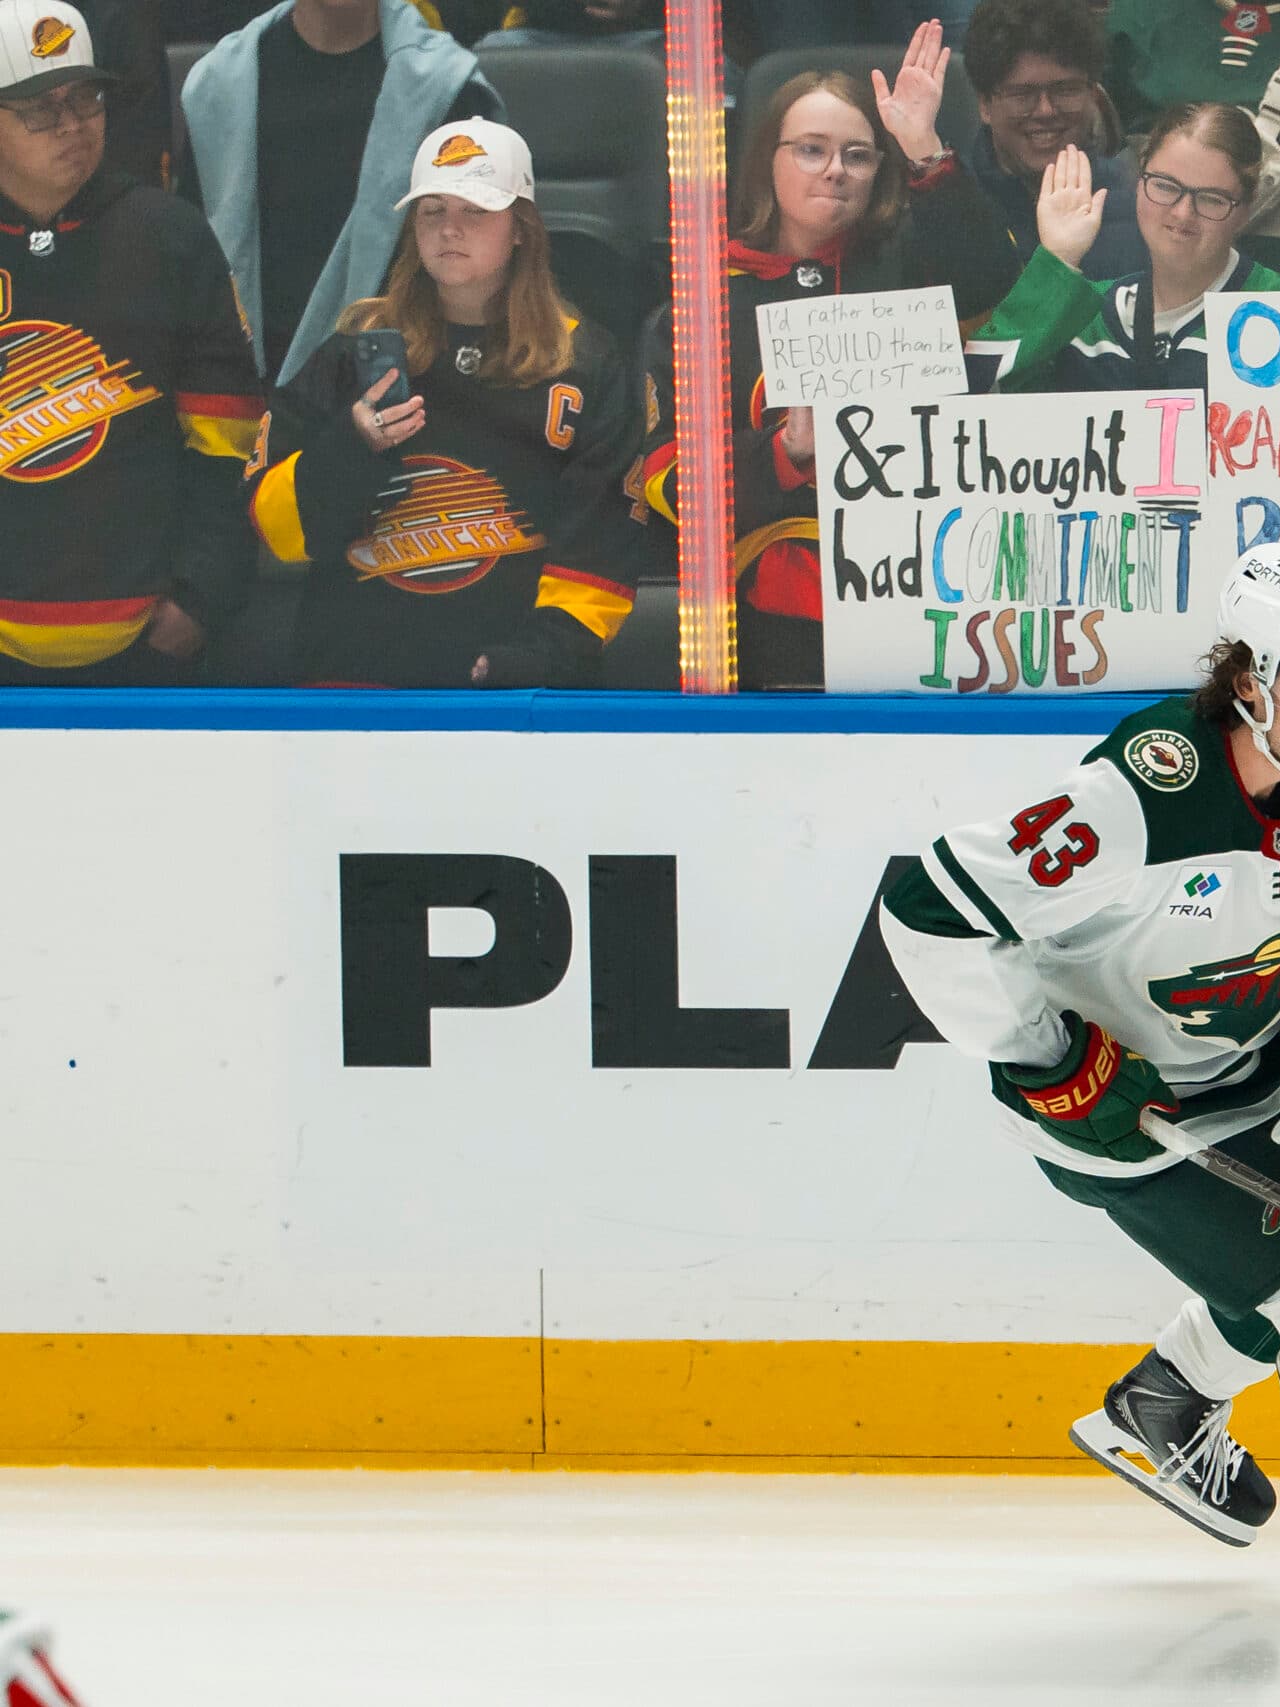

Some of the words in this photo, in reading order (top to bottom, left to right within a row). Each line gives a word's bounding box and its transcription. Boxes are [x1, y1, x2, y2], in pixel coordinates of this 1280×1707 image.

[766, 308, 791, 334] I'd
[808, 302, 863, 326] rather
[872, 298, 895, 317] be
[908, 302, 927, 312] in
[935, 298, 948, 311] a
[772, 331, 881, 369] REBUILD
[890, 327, 932, 358] than
[776, 378, 786, 392] a
[800, 362, 914, 399] FASCIST
[0, 376, 122, 458] NUCKS
[547, 383, 583, 451] C
[834, 405, 905, 501] &
[911, 405, 940, 499] I
[953, 410, 1126, 509] thought
[1133, 398, 1201, 497] I
[834, 508, 923, 601] had
[932, 507, 1201, 613] COMMITMENT
[919, 608, 1108, 693] ISSUES
[1131, 753, 1154, 778] WILD
[1151, 734, 1194, 780] MINNESOTA
[1007, 794, 1100, 887] 43
[1169, 904, 1213, 919] TRIA
[339, 852, 948, 1071] PLA
